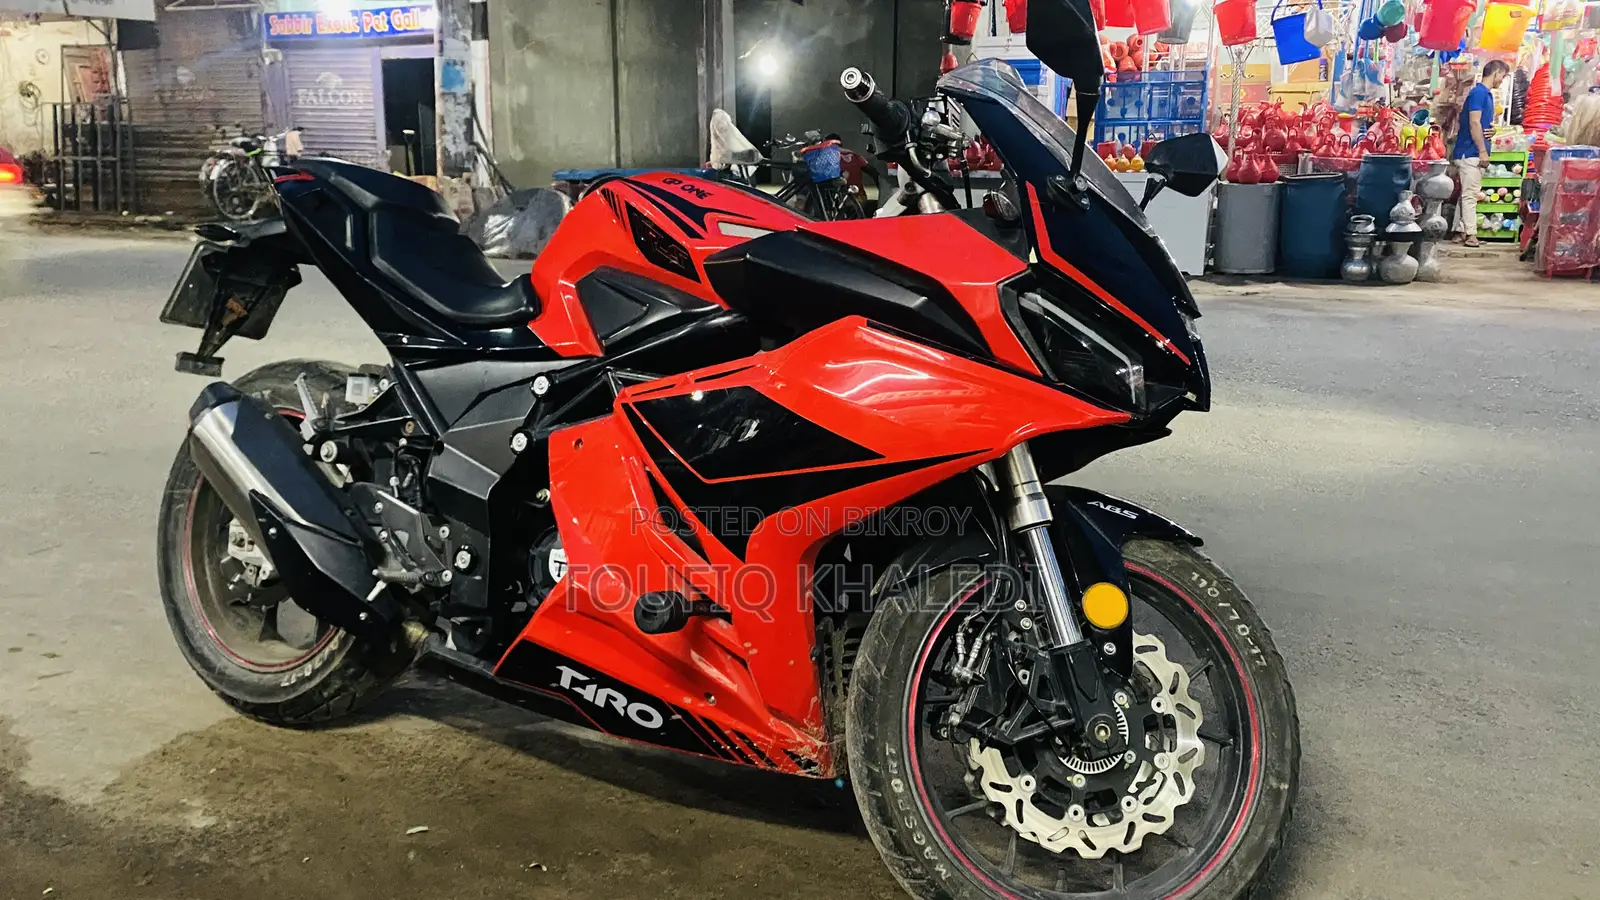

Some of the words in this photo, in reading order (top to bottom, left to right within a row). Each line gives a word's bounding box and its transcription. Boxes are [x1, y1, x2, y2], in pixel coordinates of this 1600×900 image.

[363, 11, 389, 33] Pet
[297, 88, 364, 105] FALCON
[662, 177, 683, 185] GP
[680, 184, 714, 199] ONE
[1087, 500, 1139, 520] ABS
[1192, 571, 1268, 668] 110/70-17
[556, 665, 664, 729] TARO
